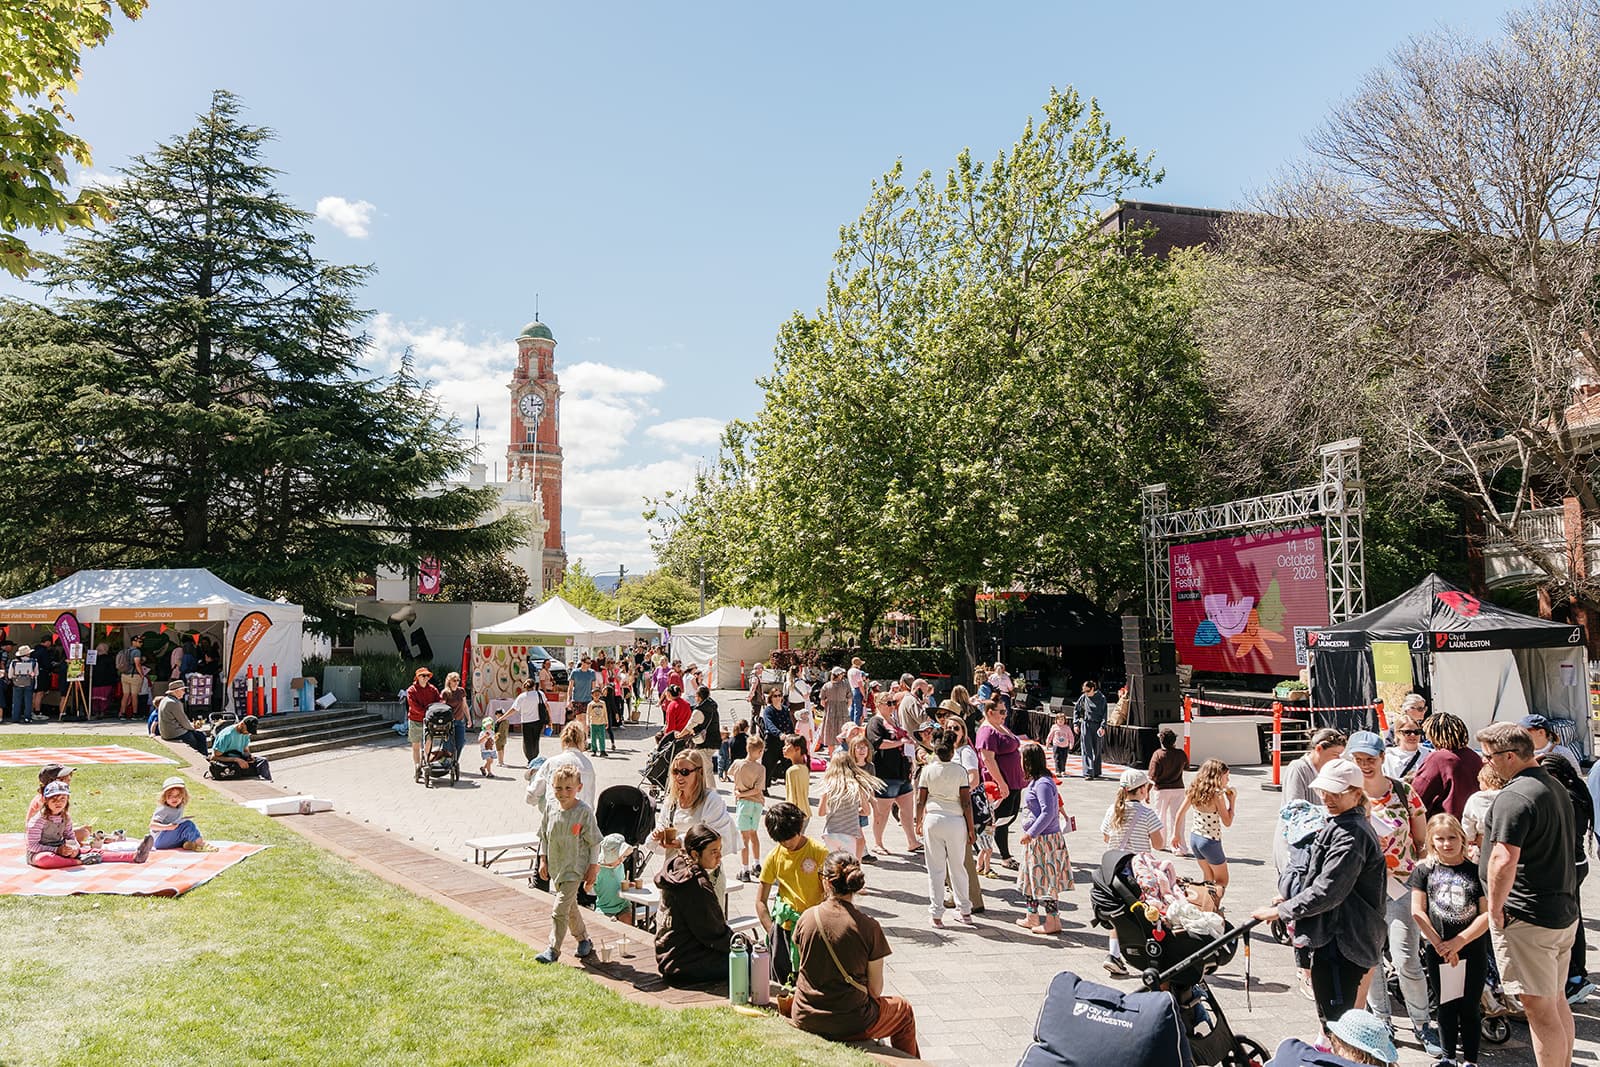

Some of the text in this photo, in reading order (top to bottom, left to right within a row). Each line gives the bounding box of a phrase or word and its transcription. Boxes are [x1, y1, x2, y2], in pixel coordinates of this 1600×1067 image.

[1304, 538, 1315, 551] 15
[1174, 553, 1190, 565] Little
[1277, 553, 1316, 567] October
[1175, 565, 1192, 577] Food
[1293, 566, 1317, 580] 2026
[1175, 576, 1200, 588] Festival
[1448, 632, 1467, 642] City of
[1449, 639, 1490, 648] LAUNCESTON
[1088, 1006, 1112, 1017] City of
[1086, 1012, 1133, 1029] LAUNCESTON
